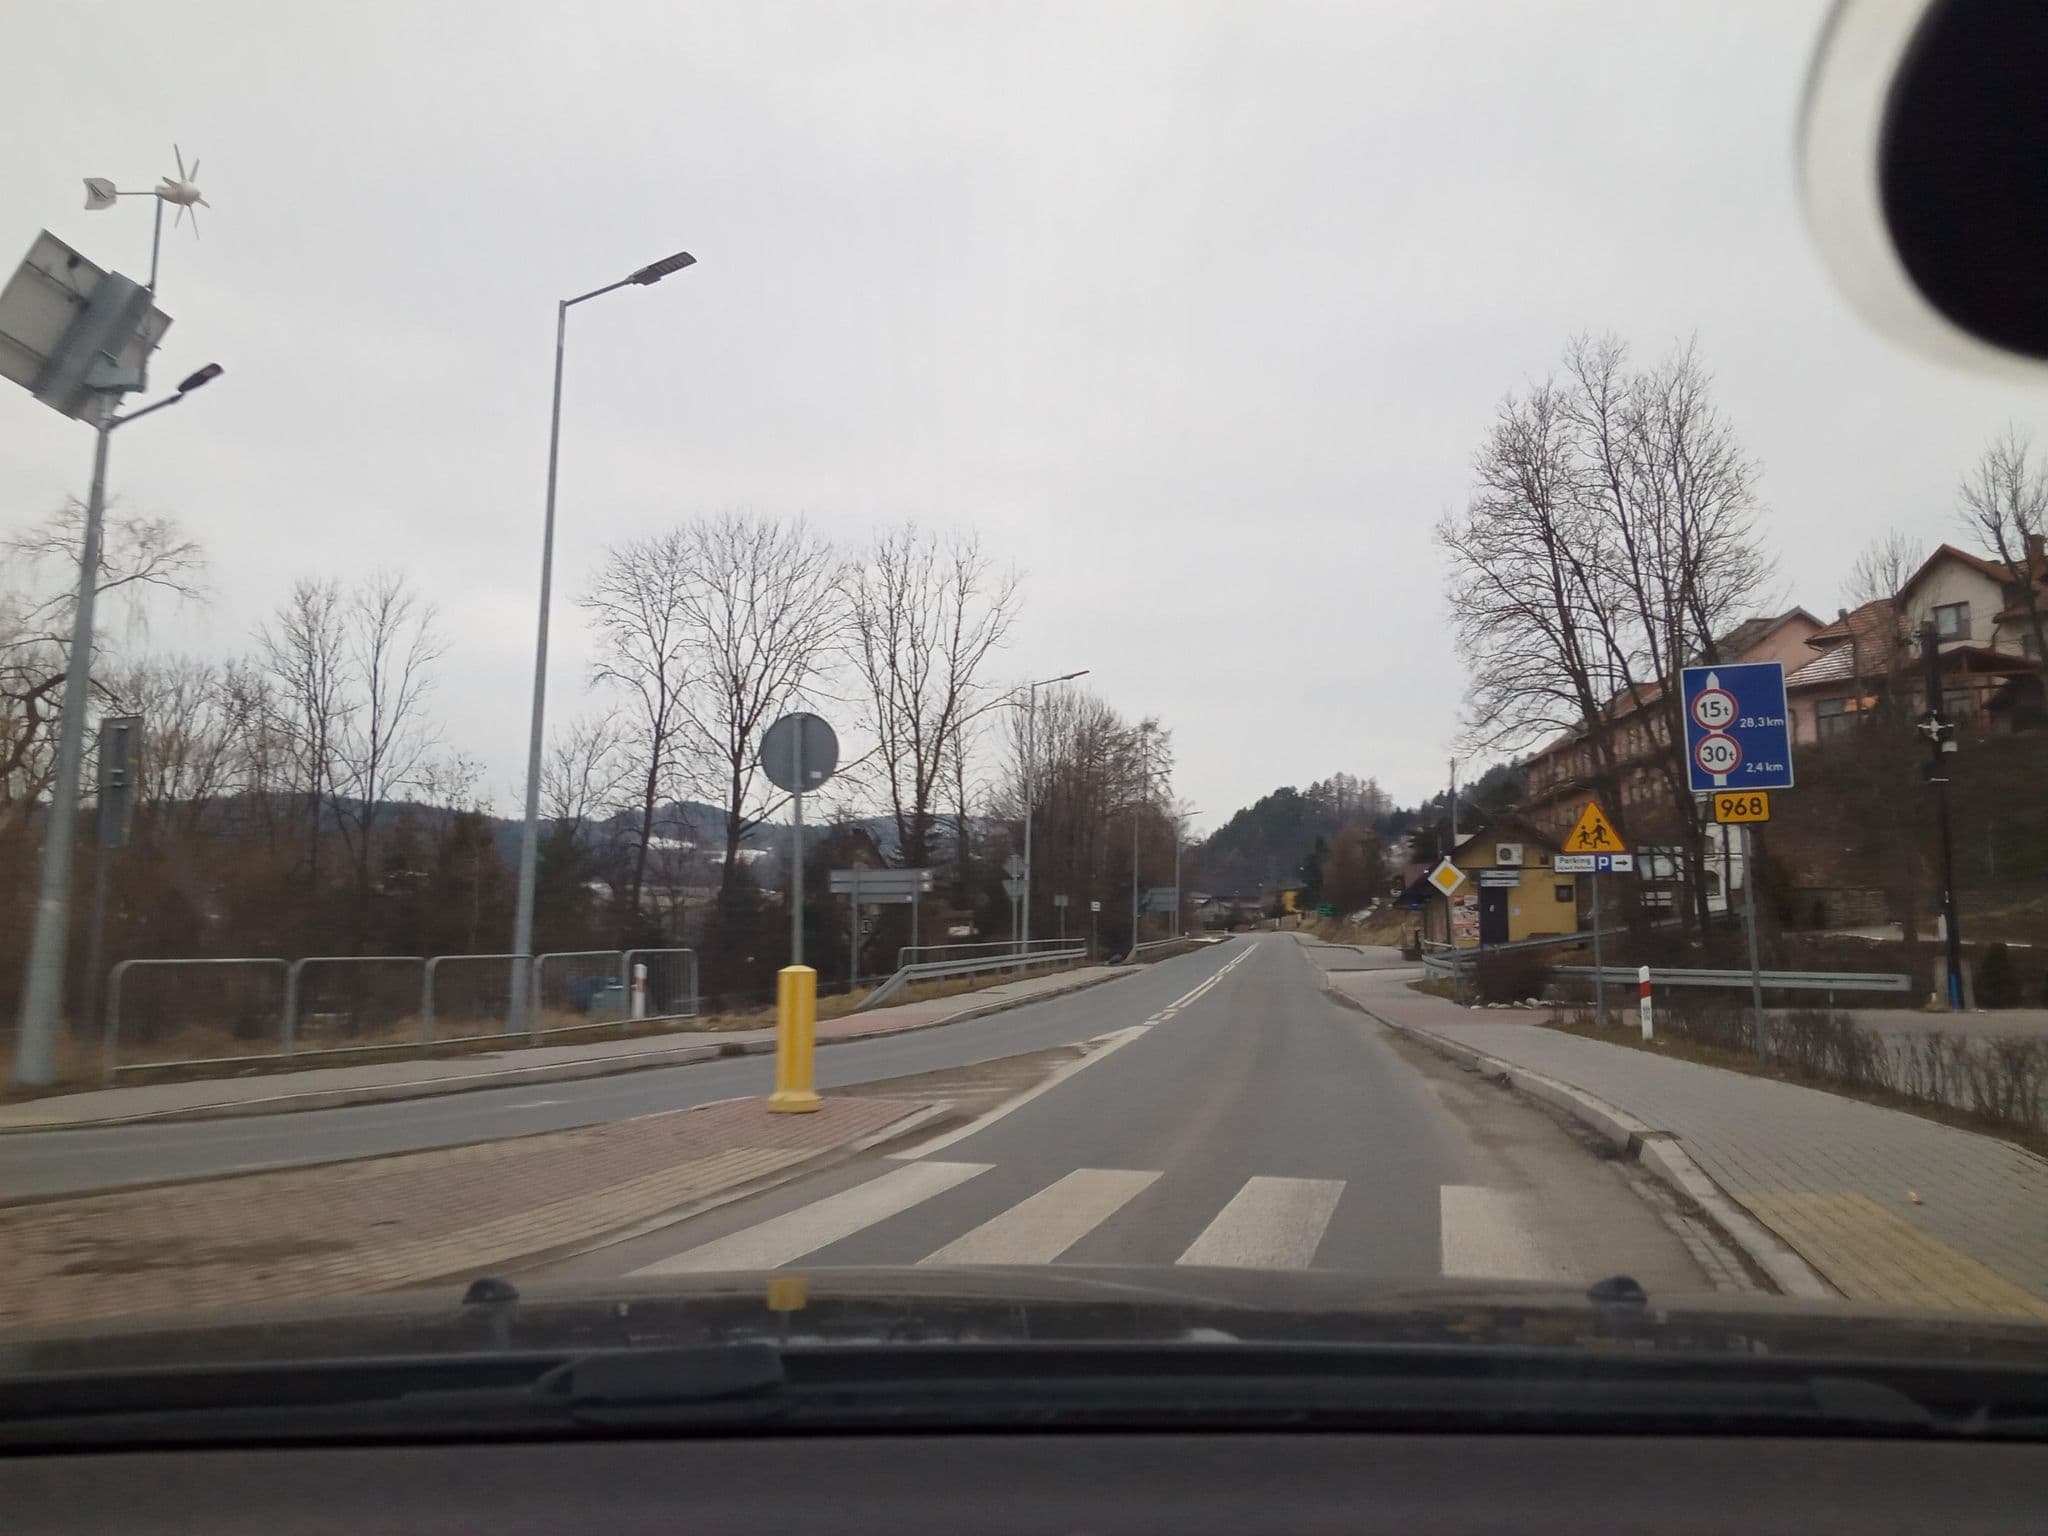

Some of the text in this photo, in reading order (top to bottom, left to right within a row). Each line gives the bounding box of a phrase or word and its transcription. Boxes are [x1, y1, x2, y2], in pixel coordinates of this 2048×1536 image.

[1739, 716, 1784, 728] 28,3 km
[1746, 762, 1784, 773] 2,4 km
[1721, 797, 1763, 817] 968
[1559, 856, 1591, 866] Parking
[1598, 856, 1609, 870] P
